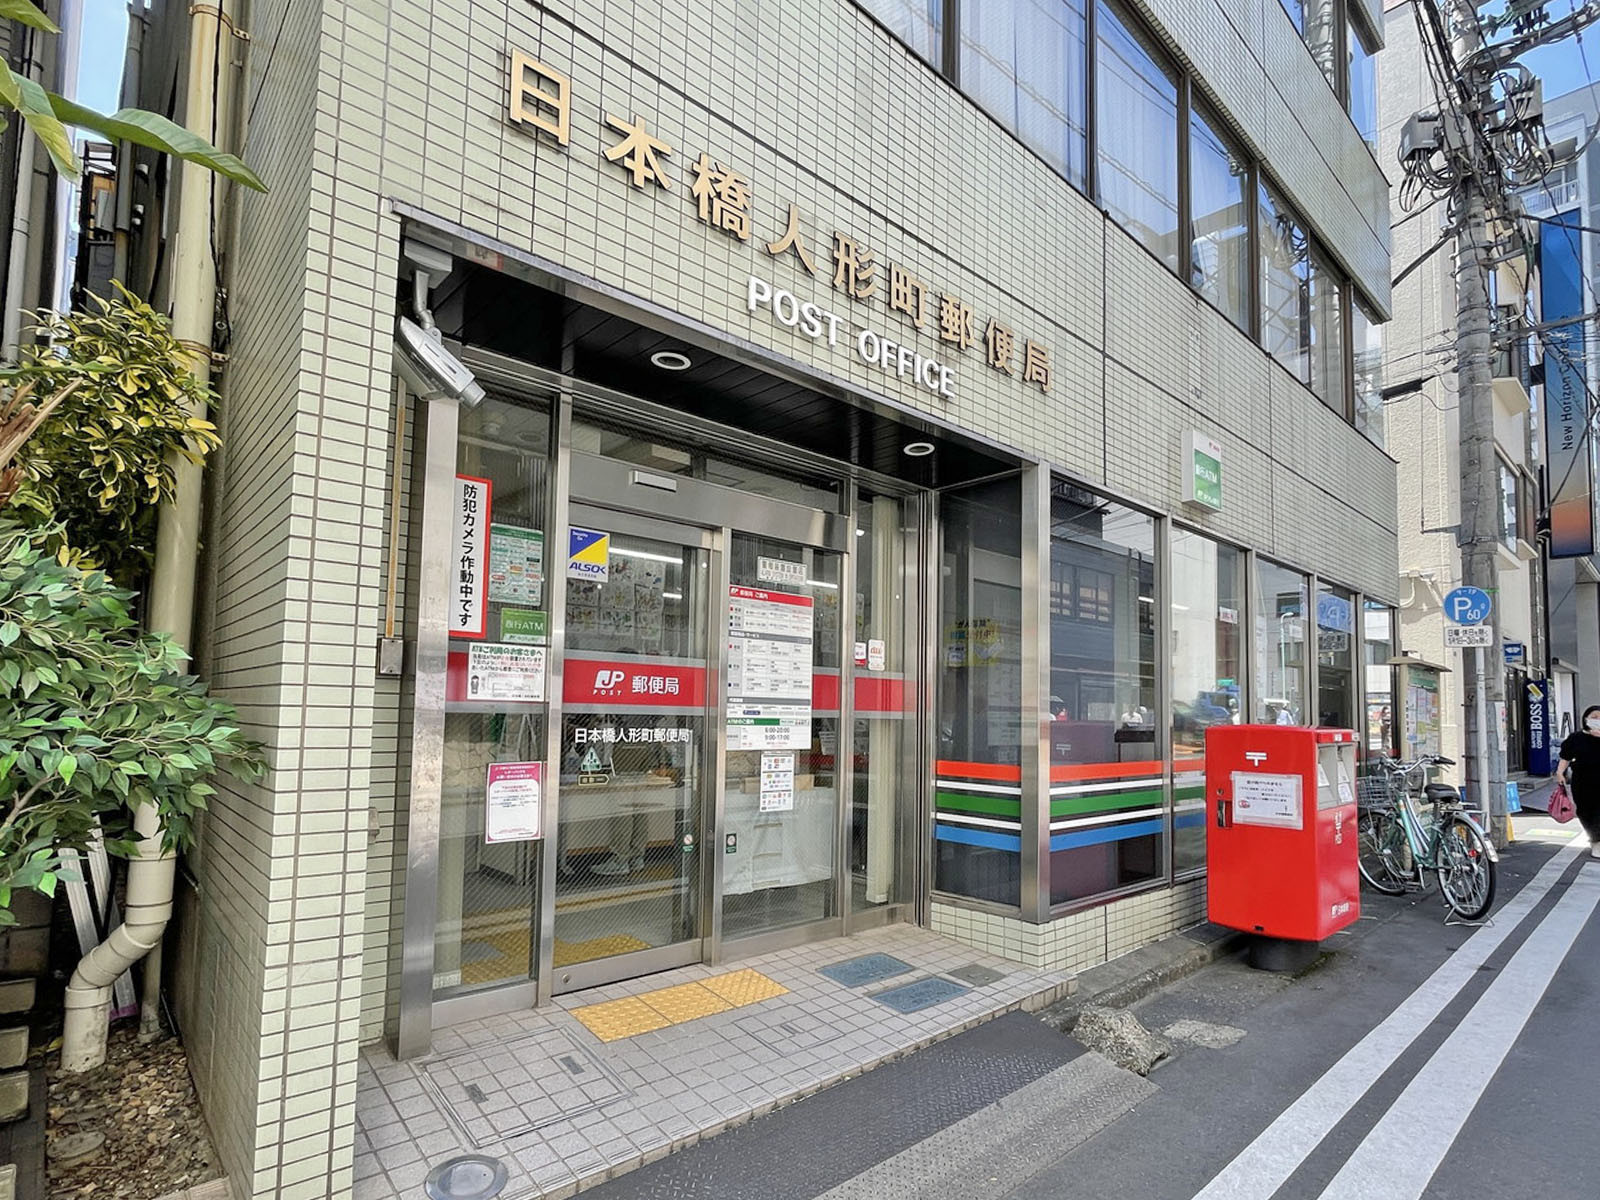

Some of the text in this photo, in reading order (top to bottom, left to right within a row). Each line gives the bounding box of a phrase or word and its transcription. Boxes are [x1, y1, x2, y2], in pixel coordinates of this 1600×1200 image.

[509, 47, 1054, 393] 日本橋人形町郵便局
[747, 275, 957, 399] POST OFFICE
[1560, 376, 1573, 422] Horizon
[1562, 425, 1574, 451] New
[458, 484, 478, 626] 防犯カメラ作動中です
[569, 562, 606, 575] ALSOK
[1454, 597, 1472, 621] P
[1467, 609, 1480, 620] 60
[631, 675, 680, 695] 郵便局
[1530, 703, 1543, 730] BOSS
[574, 727, 690, 744] 日本橋人形町郵便局
